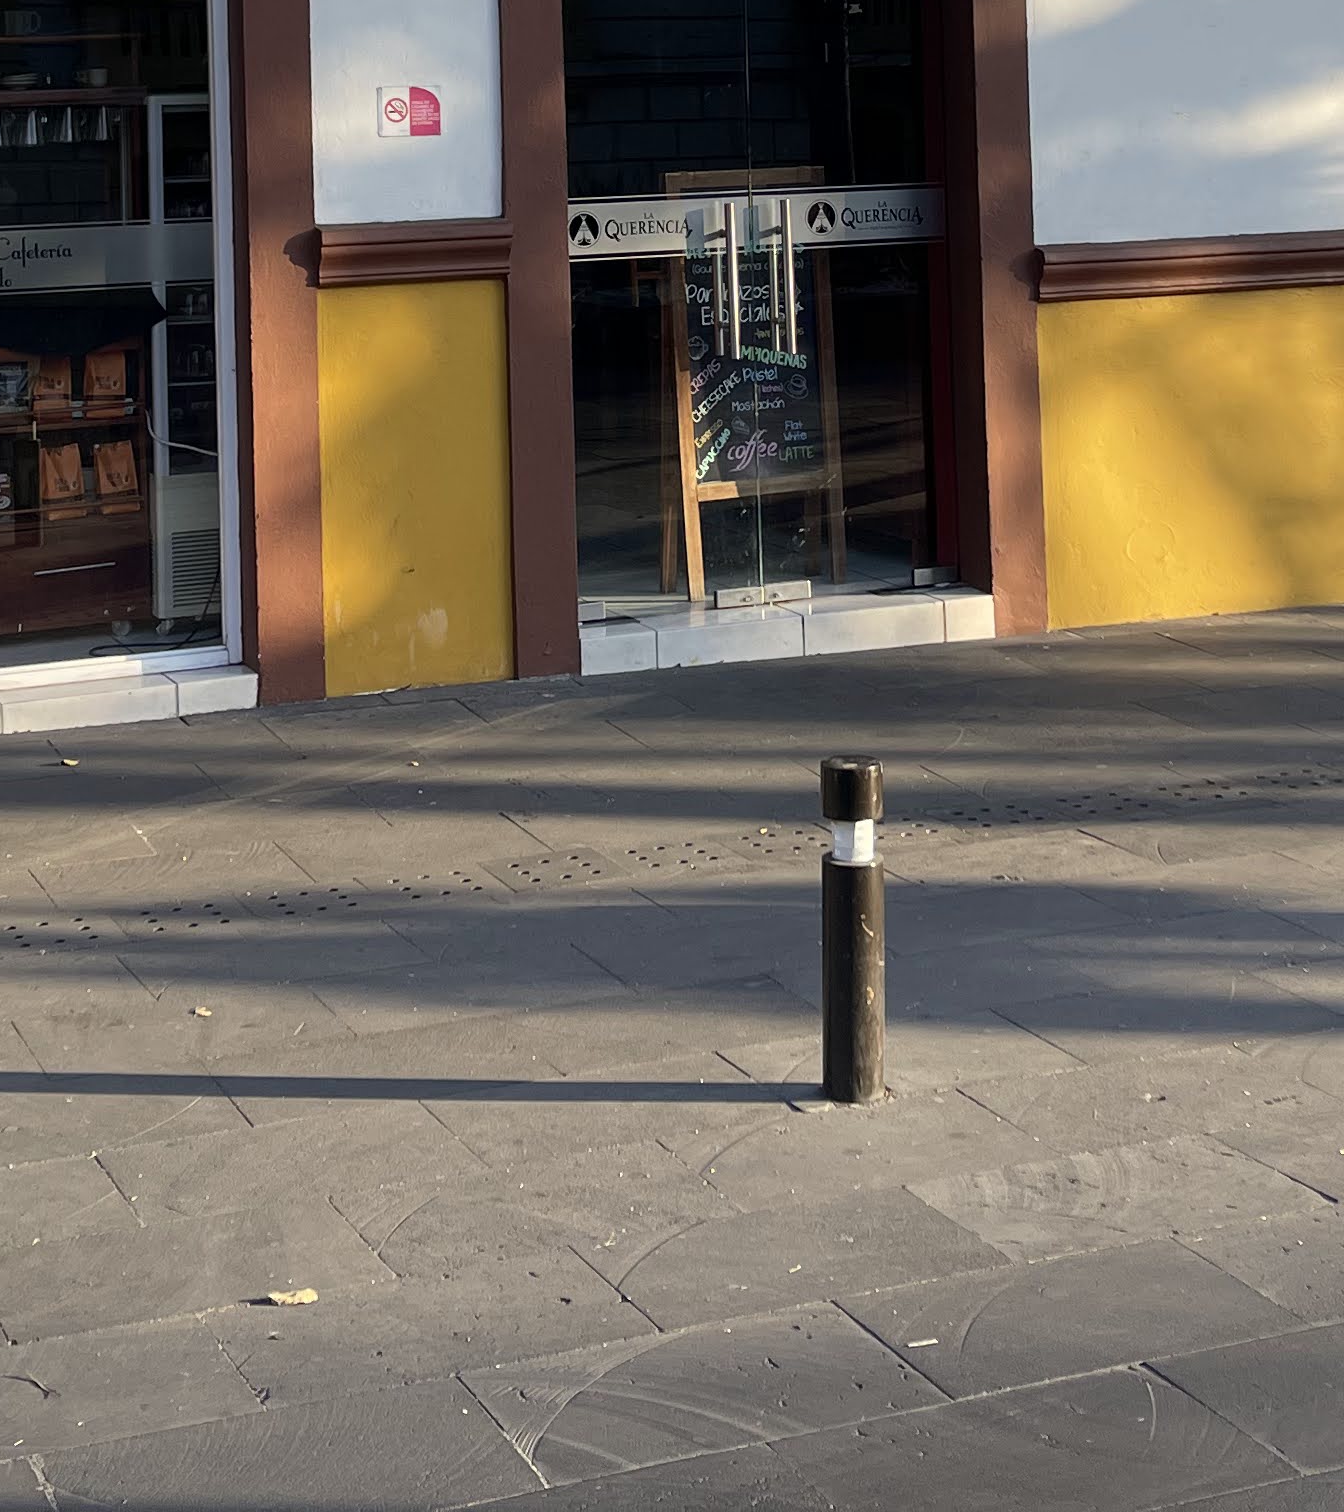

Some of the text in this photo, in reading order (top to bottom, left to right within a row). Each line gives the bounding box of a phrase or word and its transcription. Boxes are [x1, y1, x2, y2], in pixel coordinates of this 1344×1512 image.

[841, 207, 924, 229] QUERENCIA
[605, 218, 693, 242] QUERENCIA
[742, 366, 778, 382] Pastel
[692, 370, 742, 423] CHEESECAKE
[727, 428, 778, 473] coffee
[778, 445, 815, 463] LATTE
